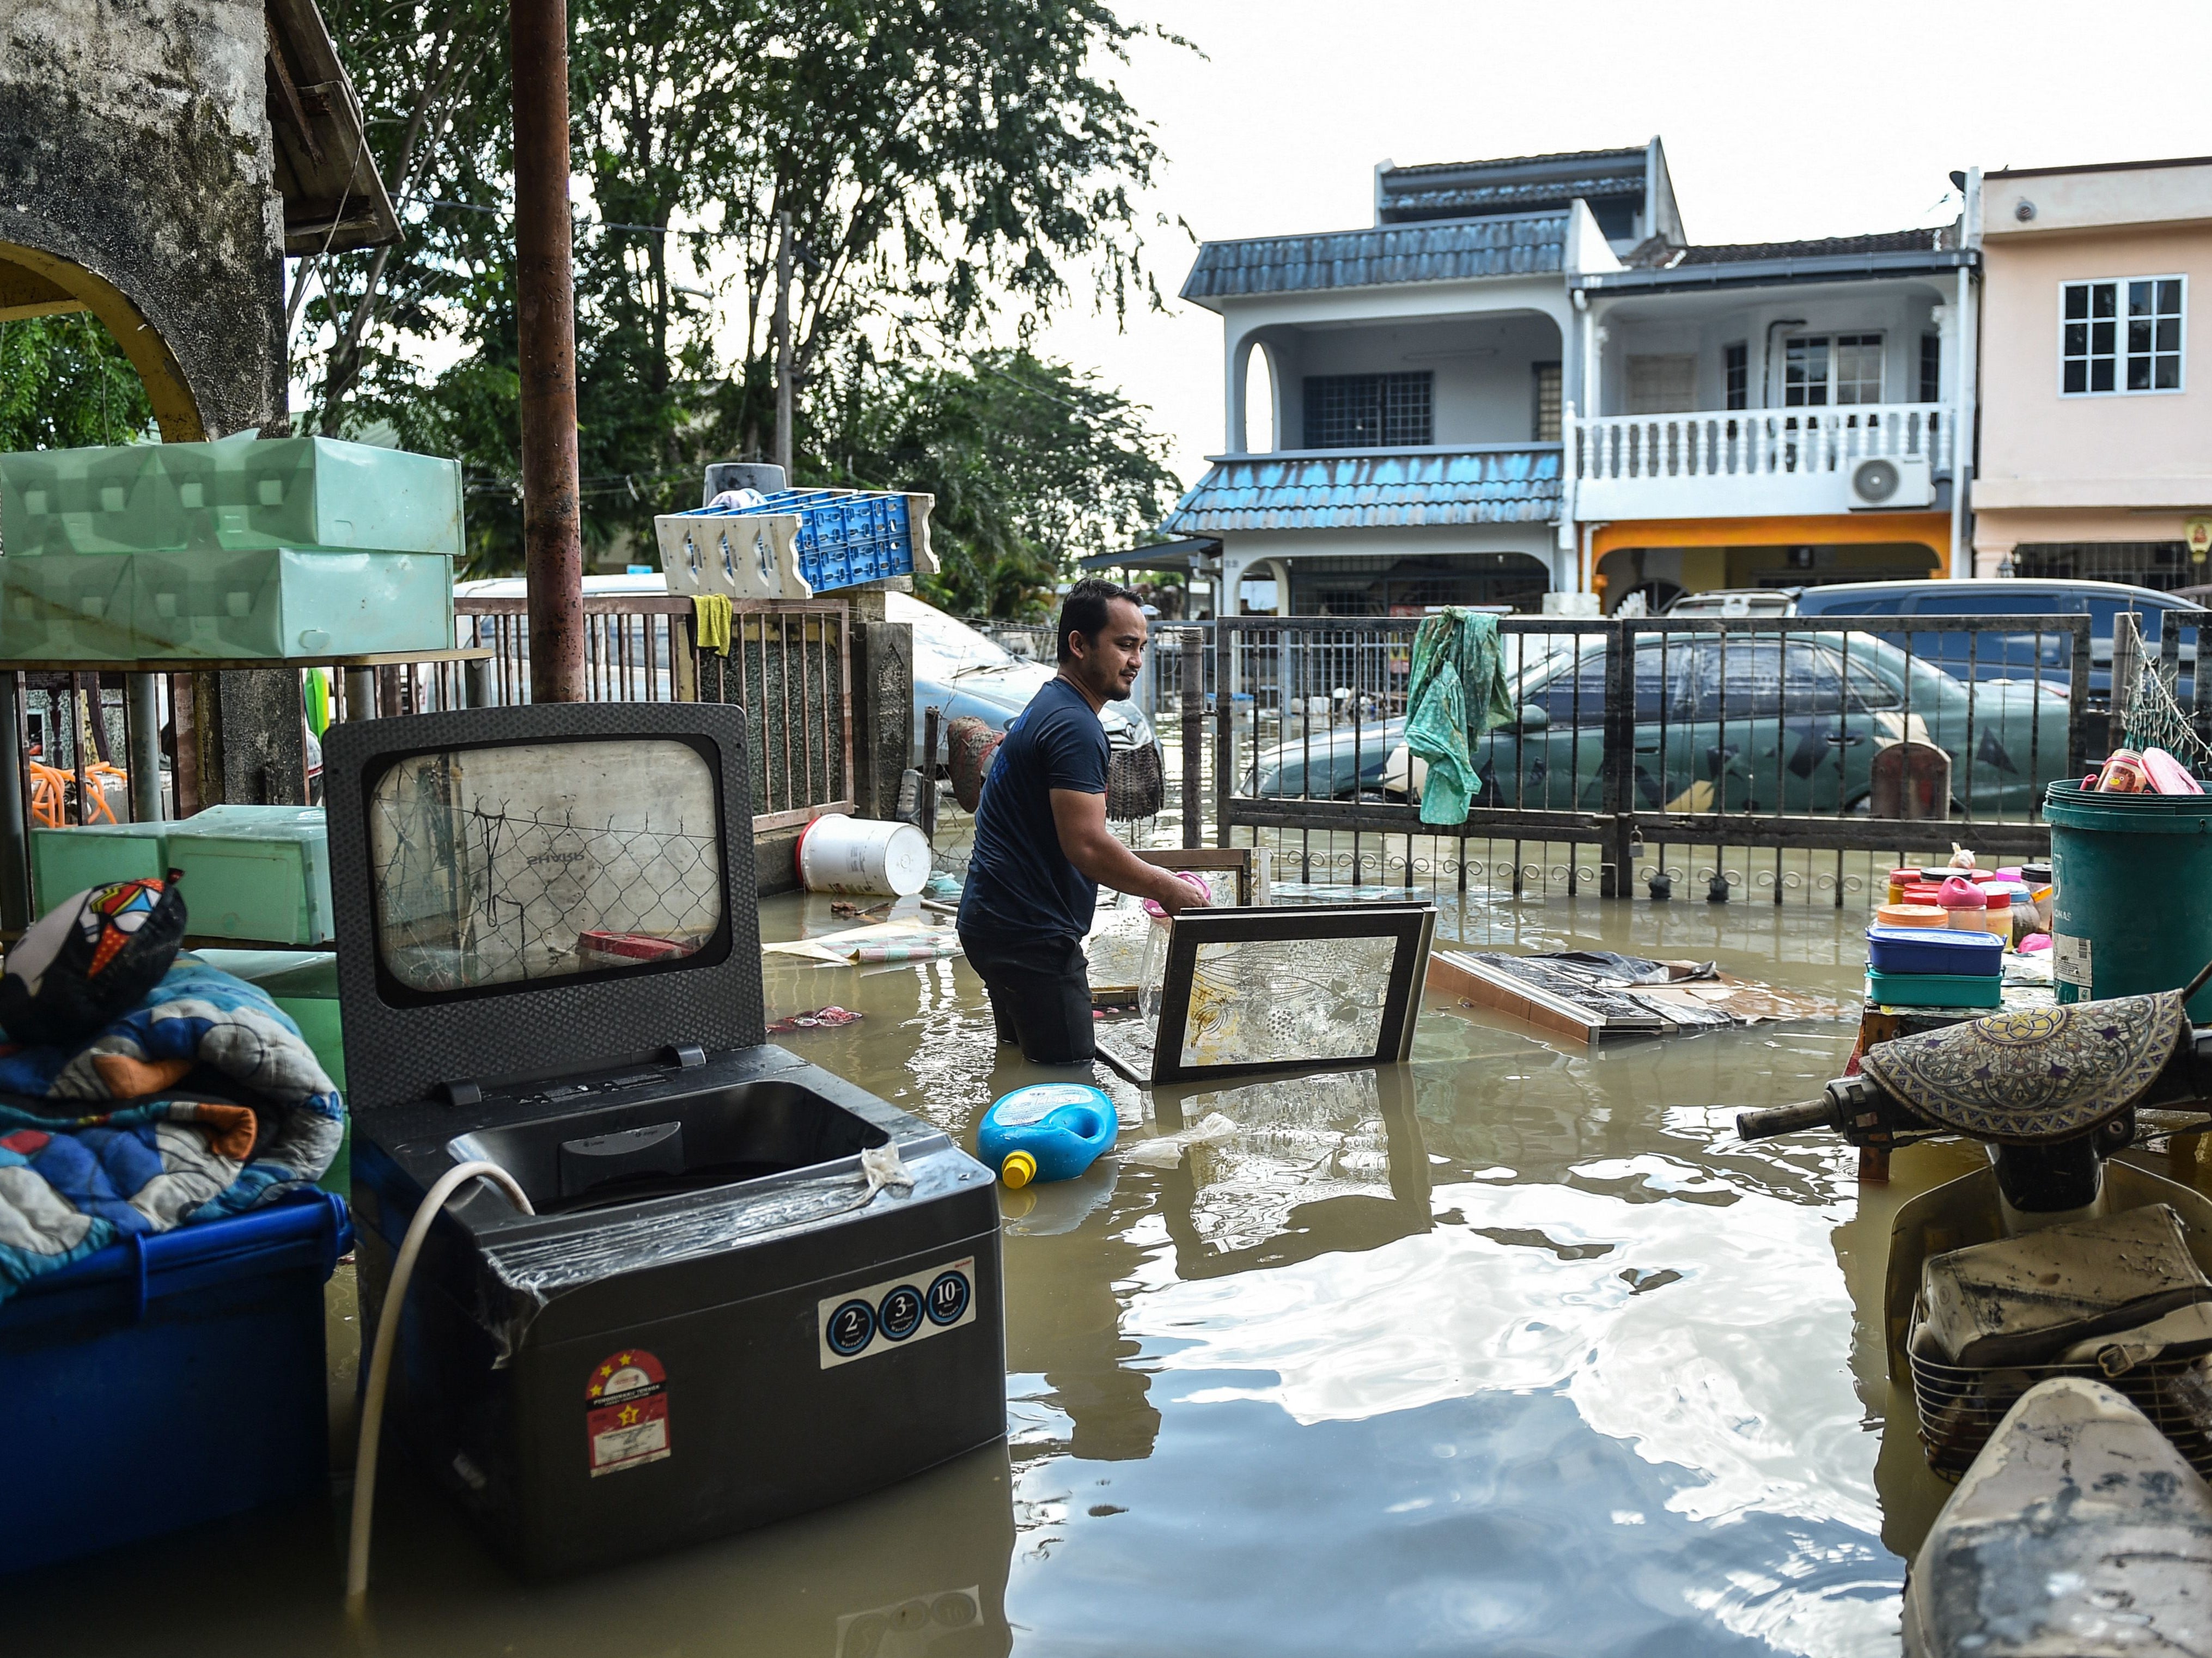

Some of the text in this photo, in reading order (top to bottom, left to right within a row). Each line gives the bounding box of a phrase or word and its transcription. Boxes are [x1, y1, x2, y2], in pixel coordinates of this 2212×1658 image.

[2054, 909, 2072, 921] ONAS
[937, 1281, 956, 1305] 10
[895, 1296, 906, 1317] 3
[939, 1305, 959, 1317] Warranty
[845, 1310, 858, 1332] 2
[891, 1320, 913, 1332] Warranty
[841, 1335, 864, 1347] Warranty
